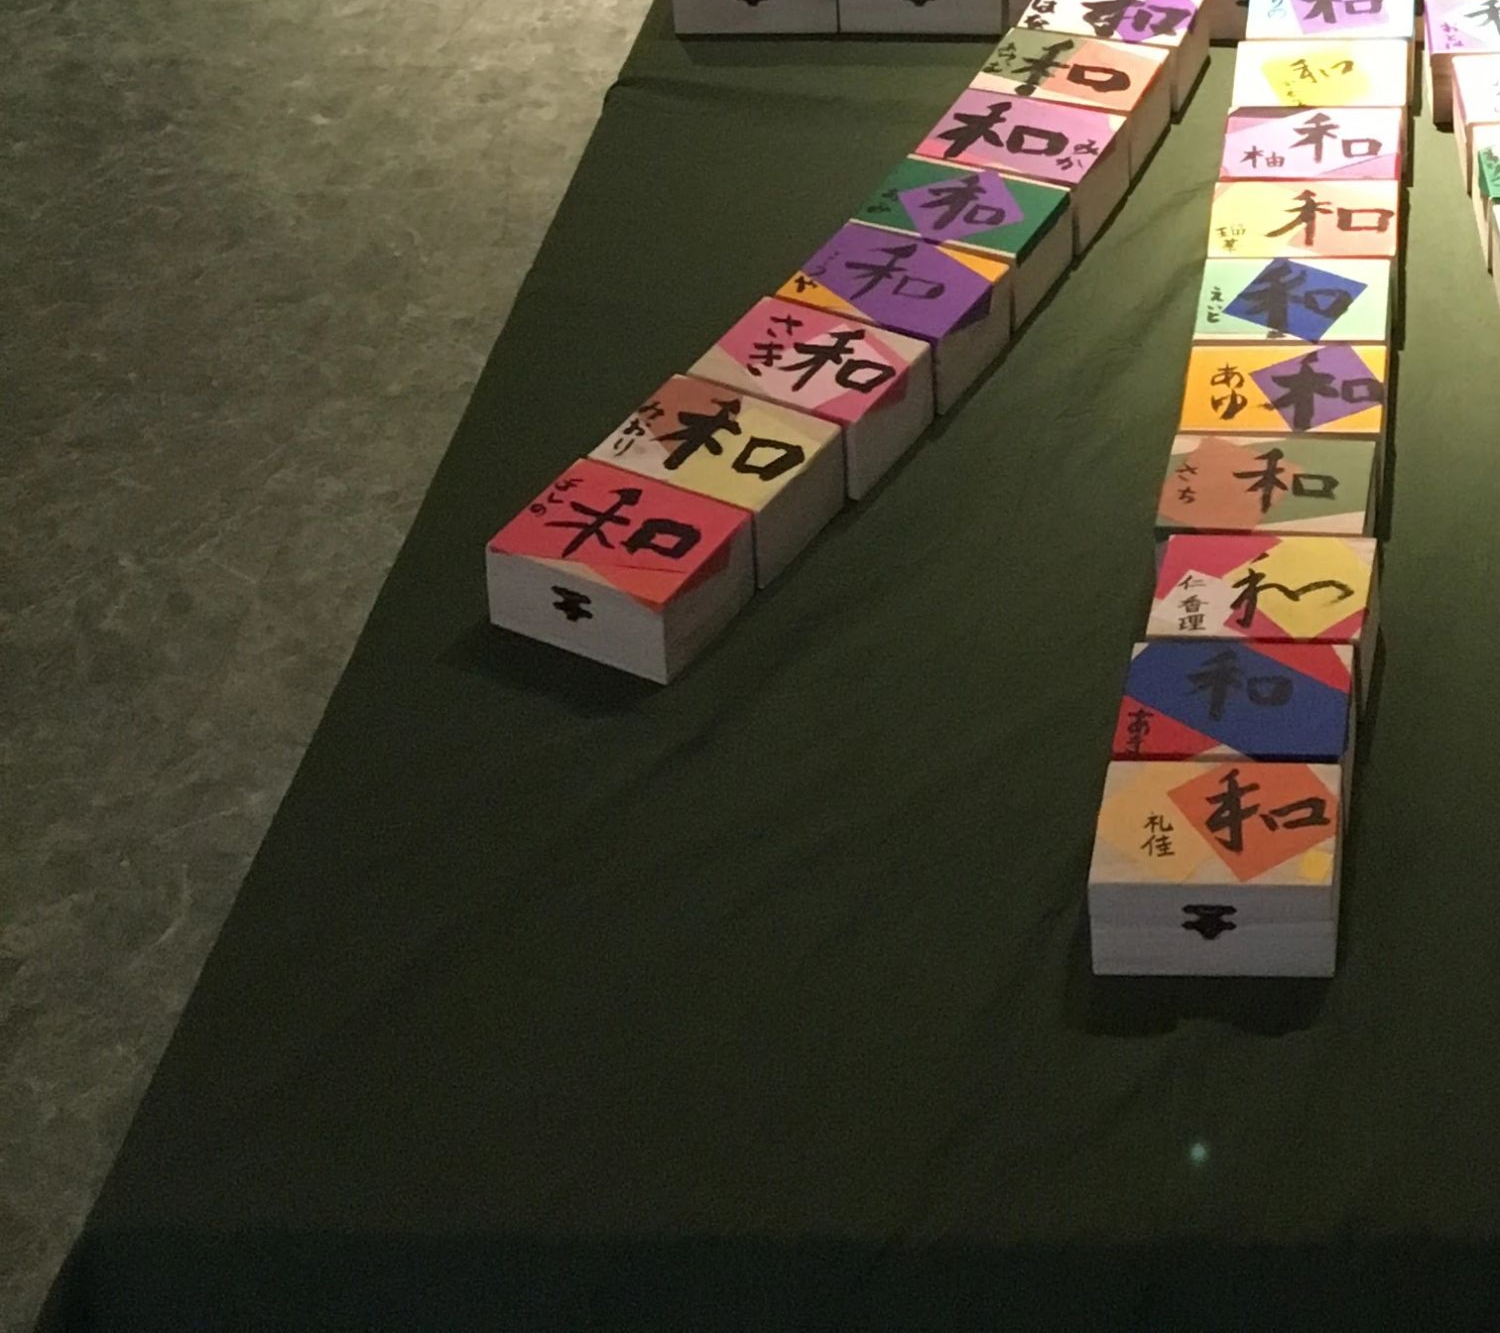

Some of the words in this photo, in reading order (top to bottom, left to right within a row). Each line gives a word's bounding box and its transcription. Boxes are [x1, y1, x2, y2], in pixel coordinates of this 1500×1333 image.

[1011, 39, 1131, 97] 和
[936, 102, 1069, 159] 和
[1240, 145, 1286, 169] 柚
[1289, 113, 1383, 164] 和
[919, 174, 1006, 230] 和
[1264, 189, 1395, 247] 和
[845, 243, 946, 300] 和
[1237, 262, 1351, 339] 和
[777, 329, 896, 392] 和
[1210, 362, 1248, 421] あゆ
[1257, 350, 1385, 432] 和
[650, 399, 806, 481] 和
[1232, 448, 1340, 514] 和
[544, 488, 703, 559] 和
[1230, 552, 1355, 629] 和
[1140, 811, 1176, 857] 礼佳
[1205, 768, 1331, 853] 和
